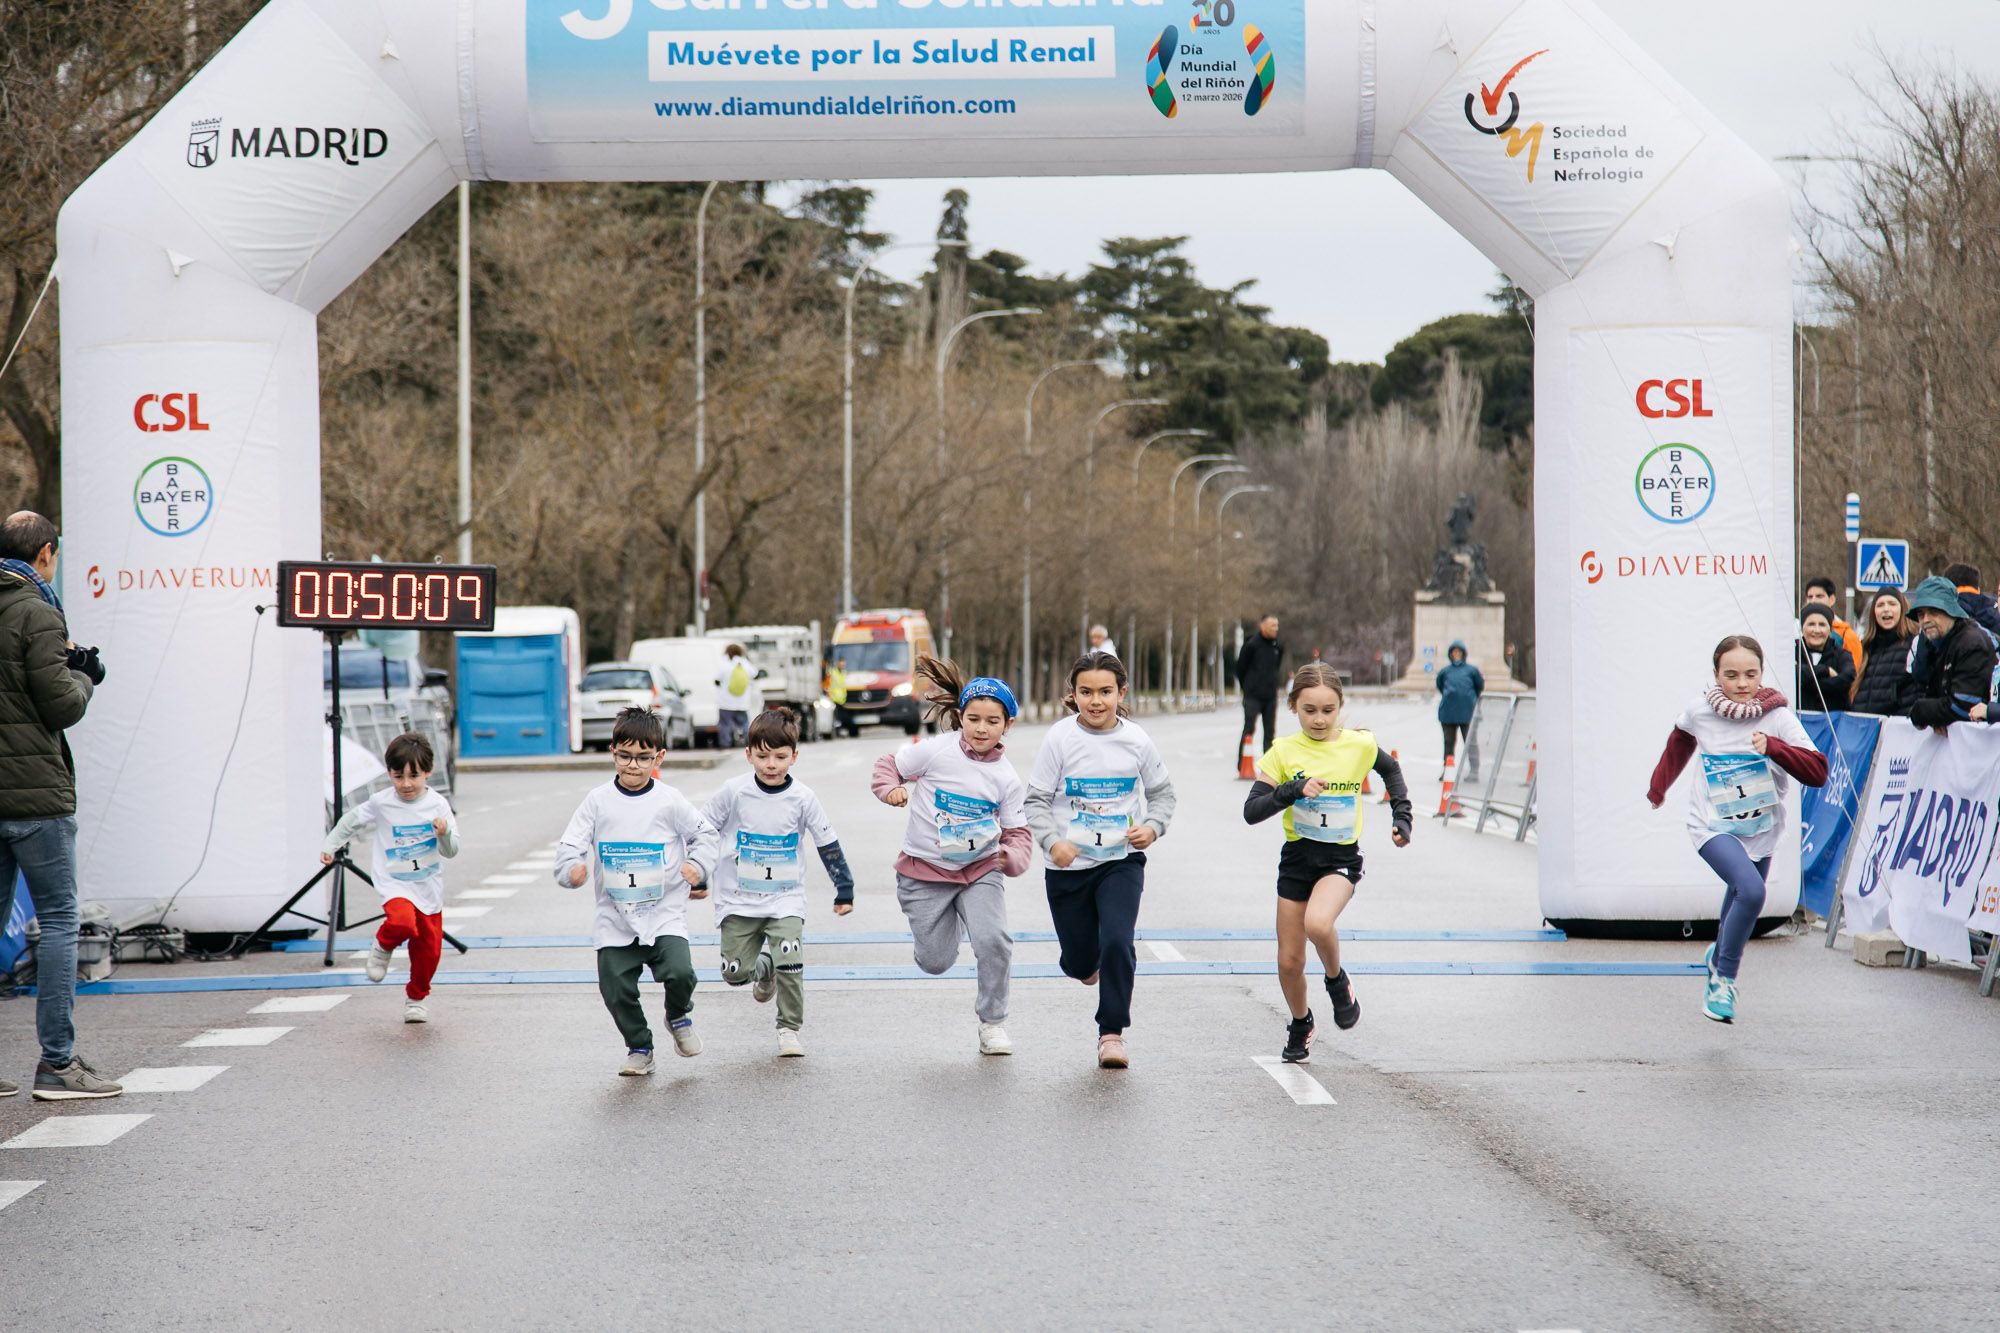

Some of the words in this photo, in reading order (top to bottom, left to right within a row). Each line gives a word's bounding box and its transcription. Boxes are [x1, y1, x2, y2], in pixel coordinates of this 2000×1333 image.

[667, 41, 801, 65] Muévete
[811, 48, 863, 72] por
[873, 39, 901, 64] la
[911, 38, 999, 64] Salud
[1009, 37, 1095, 63] Renal
[1180, 44, 1203, 55] Día
[1180, 60, 1237, 72] Mundial
[1181, 77, 1202, 88] del
[1205, 77, 1245, 88] Riñón
[654, 94, 1016, 116] www.diamundialdelriñon.com
[1182, 93, 1192, 102] 12
[1194, 94, 1220, 102] marzo
[1222, 93, 1243, 101] 2026
[1552, 125, 1627, 139] Sociedad
[231, 127, 388, 166] MADRID
[1553, 145, 1629, 163] Española
[1635, 146, 1654, 159] de
[1635, 378, 1714, 418] CSL
[134, 392, 210, 433] CSL
[1642, 477, 1709, 490] BAYER
[1669, 450, 1684, 517] BAYER
[140, 490, 206, 504] BAYER
[166, 463, 180, 530] BAYER
[1618, 554, 1768, 577] DIAVERUM
[118, 567, 273, 591] DIAVERUM
[294, 571, 482, 621] 00:50:09
[1736, 785, 1747, 799] 1
[1320, 813, 1328, 828] 1
[968, 839, 976, 852] 1
[1095, 832, 1103, 847] 1
[412, 859, 420, 871] 1
[628, 873, 637, 888] 1
[765, 867, 773, 880] 1
